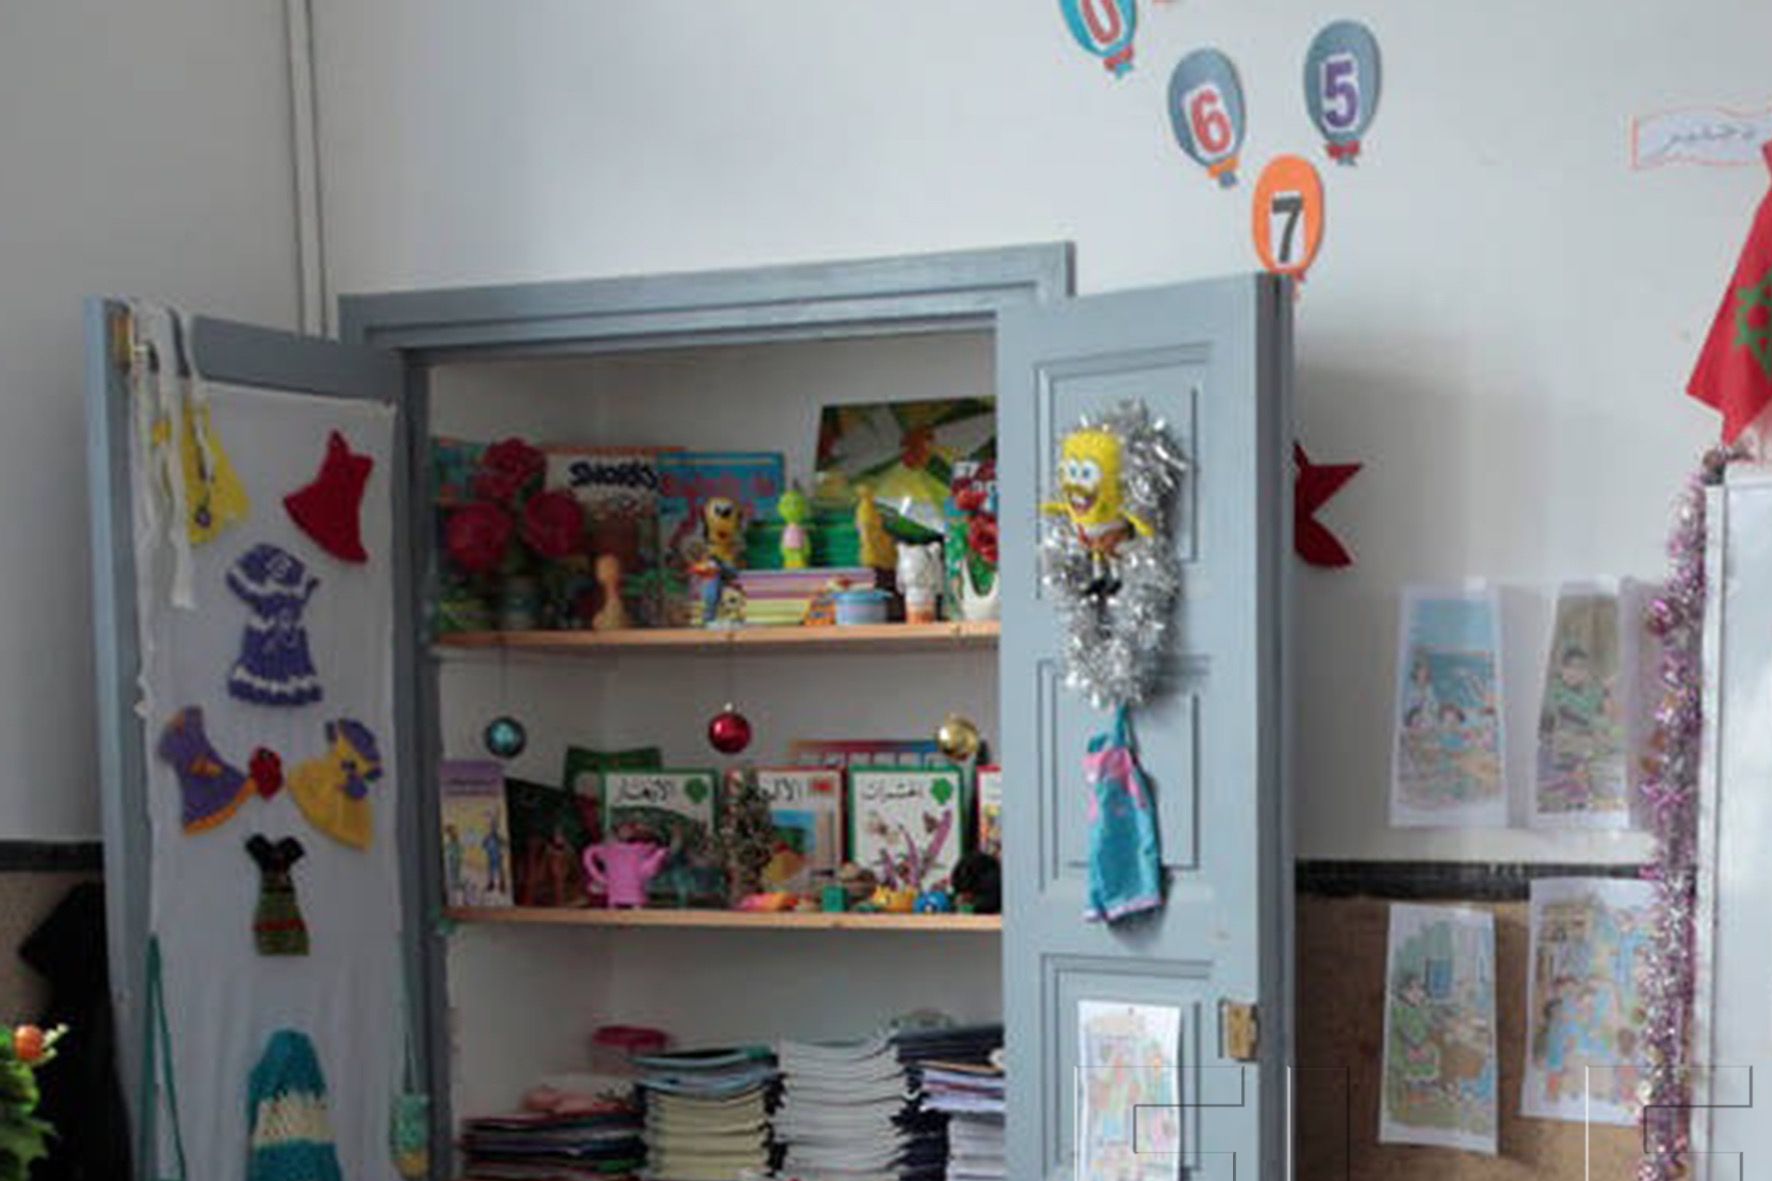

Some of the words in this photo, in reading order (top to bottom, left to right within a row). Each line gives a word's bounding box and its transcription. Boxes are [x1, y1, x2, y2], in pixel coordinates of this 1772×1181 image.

[1189, 91, 1232, 154] 6
[1323, 59, 1359, 129] 5
[1272, 197, 1304, 263] 7
